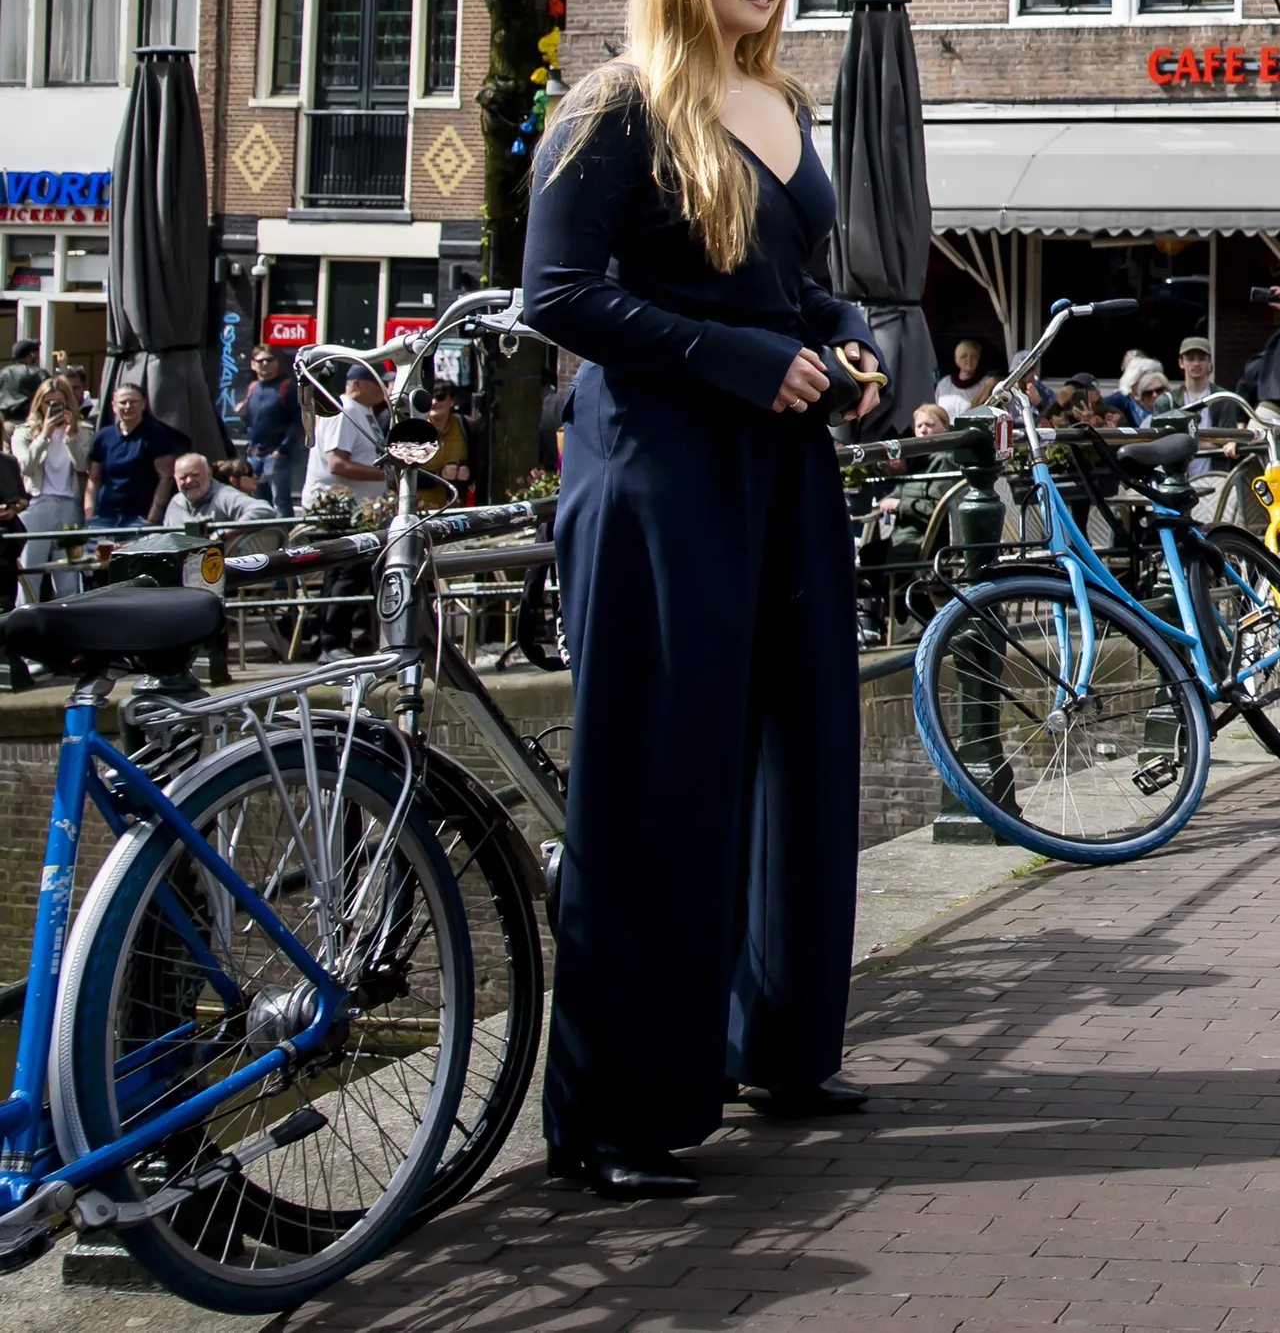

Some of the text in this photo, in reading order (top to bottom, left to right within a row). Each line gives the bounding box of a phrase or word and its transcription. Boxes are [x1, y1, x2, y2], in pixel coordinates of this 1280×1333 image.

[1147, 46, 1246, 84] CAFE
[0, 171, 111, 206] VORI
[72, 209, 87, 222] &
[273, 324, 305, 339] Cash
